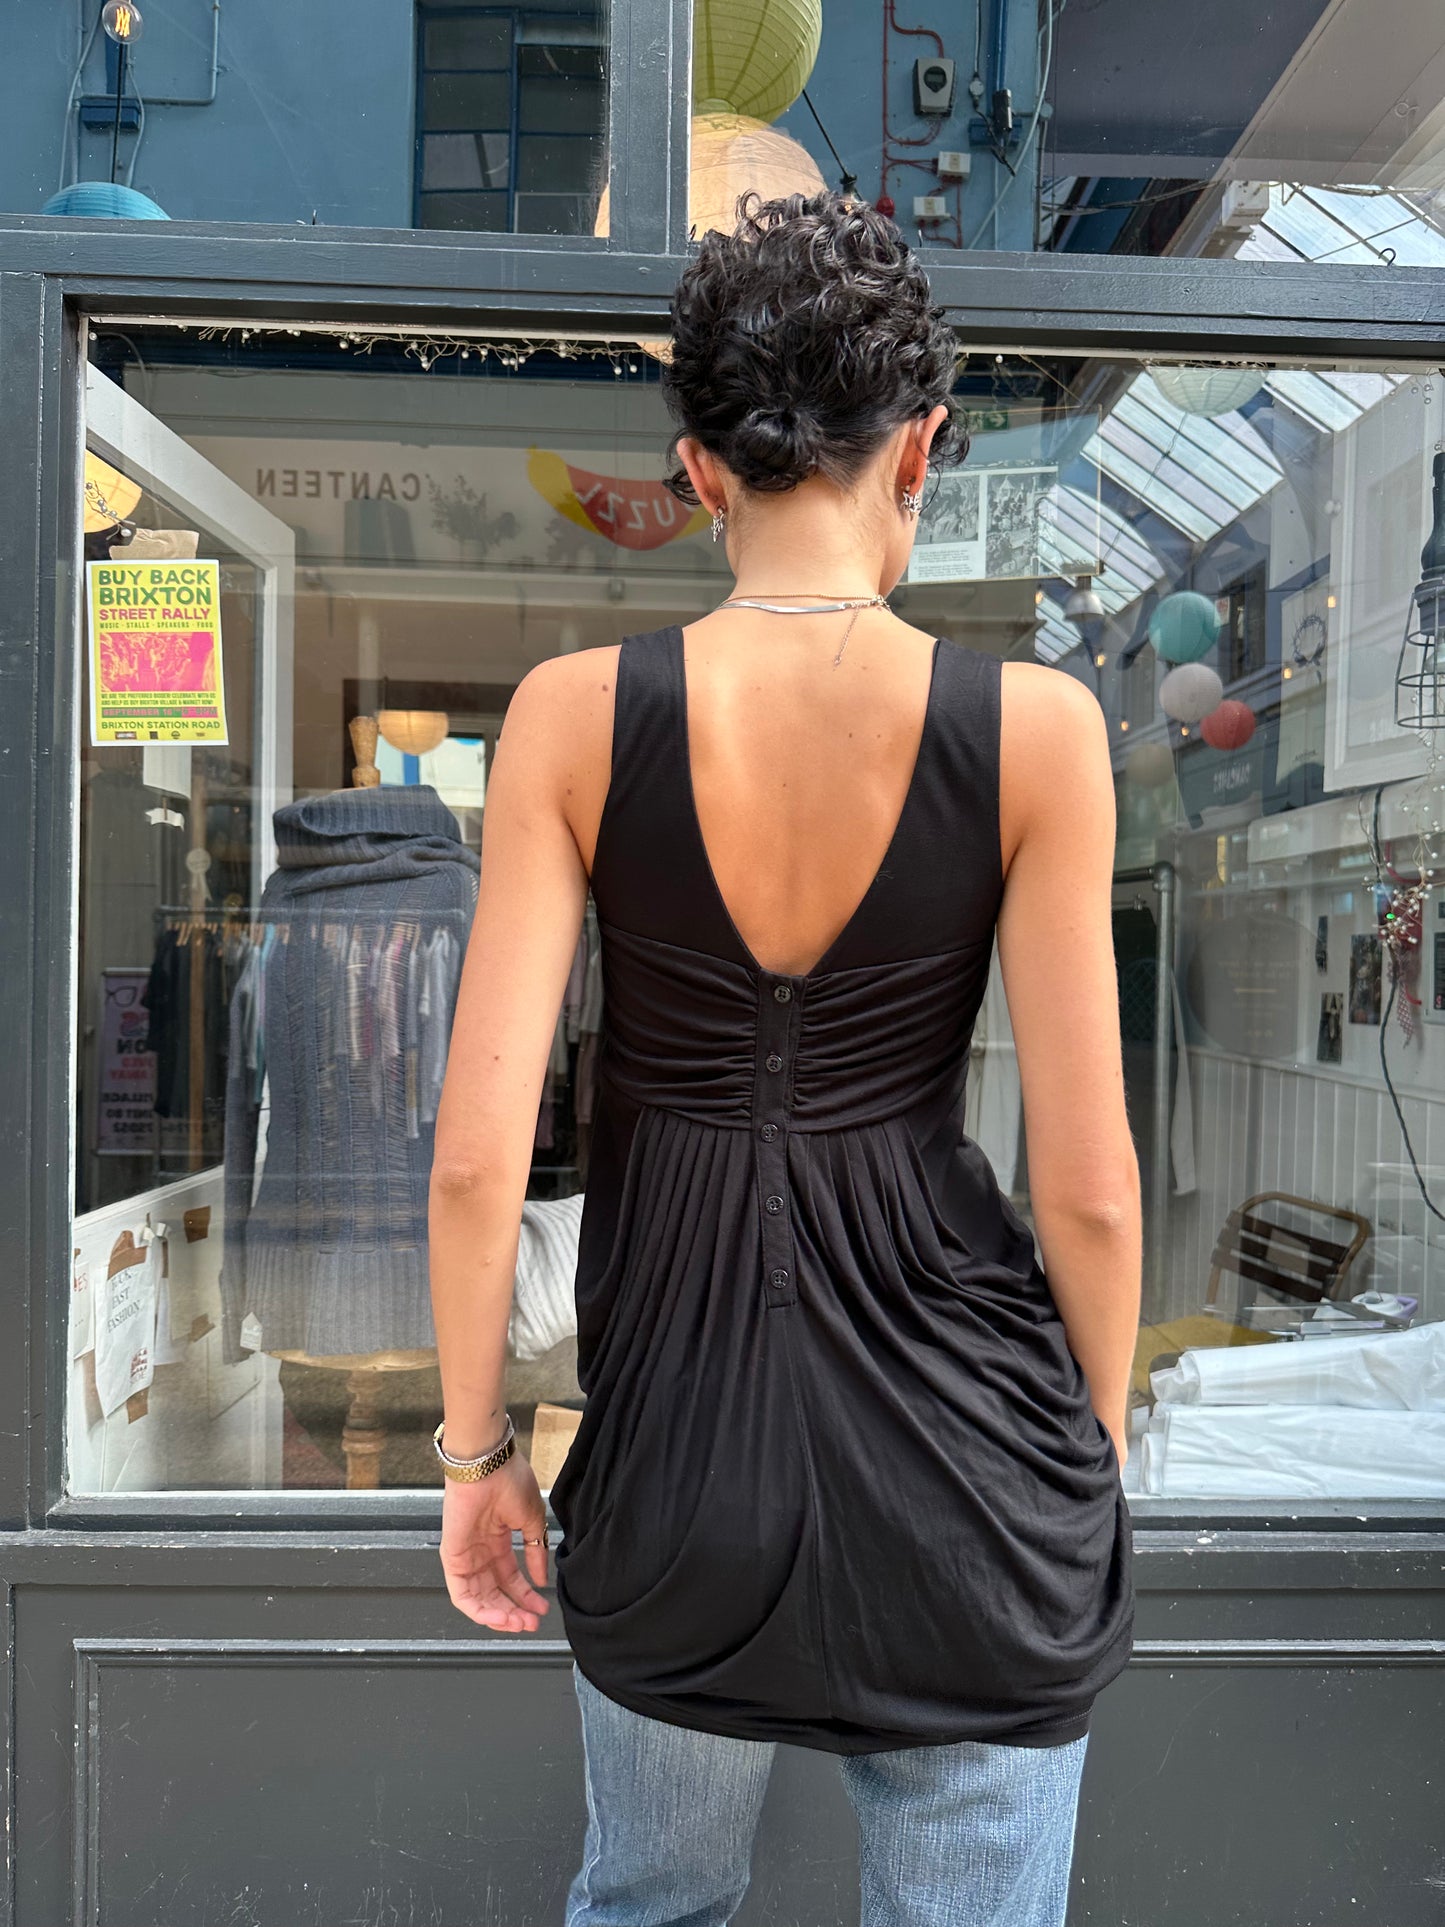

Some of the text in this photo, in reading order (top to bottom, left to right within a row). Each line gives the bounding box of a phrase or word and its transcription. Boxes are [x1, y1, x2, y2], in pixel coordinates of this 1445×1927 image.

[99, 569, 210, 585] BUY BACK
[99, 586, 212, 605] BRIXTON
[99, 607, 210, 620] STREET RALLY
[100, 621, 119, 629] MUSIC
[126, 621, 150, 629] STALLS
[103, 708, 159, 716] SEPTEMBER
[101, 721, 221, 729] BRIXTON STATION ROAD
[112, 1286, 130, 1309] FAST
[107, 1299, 143, 1333] FASHION
